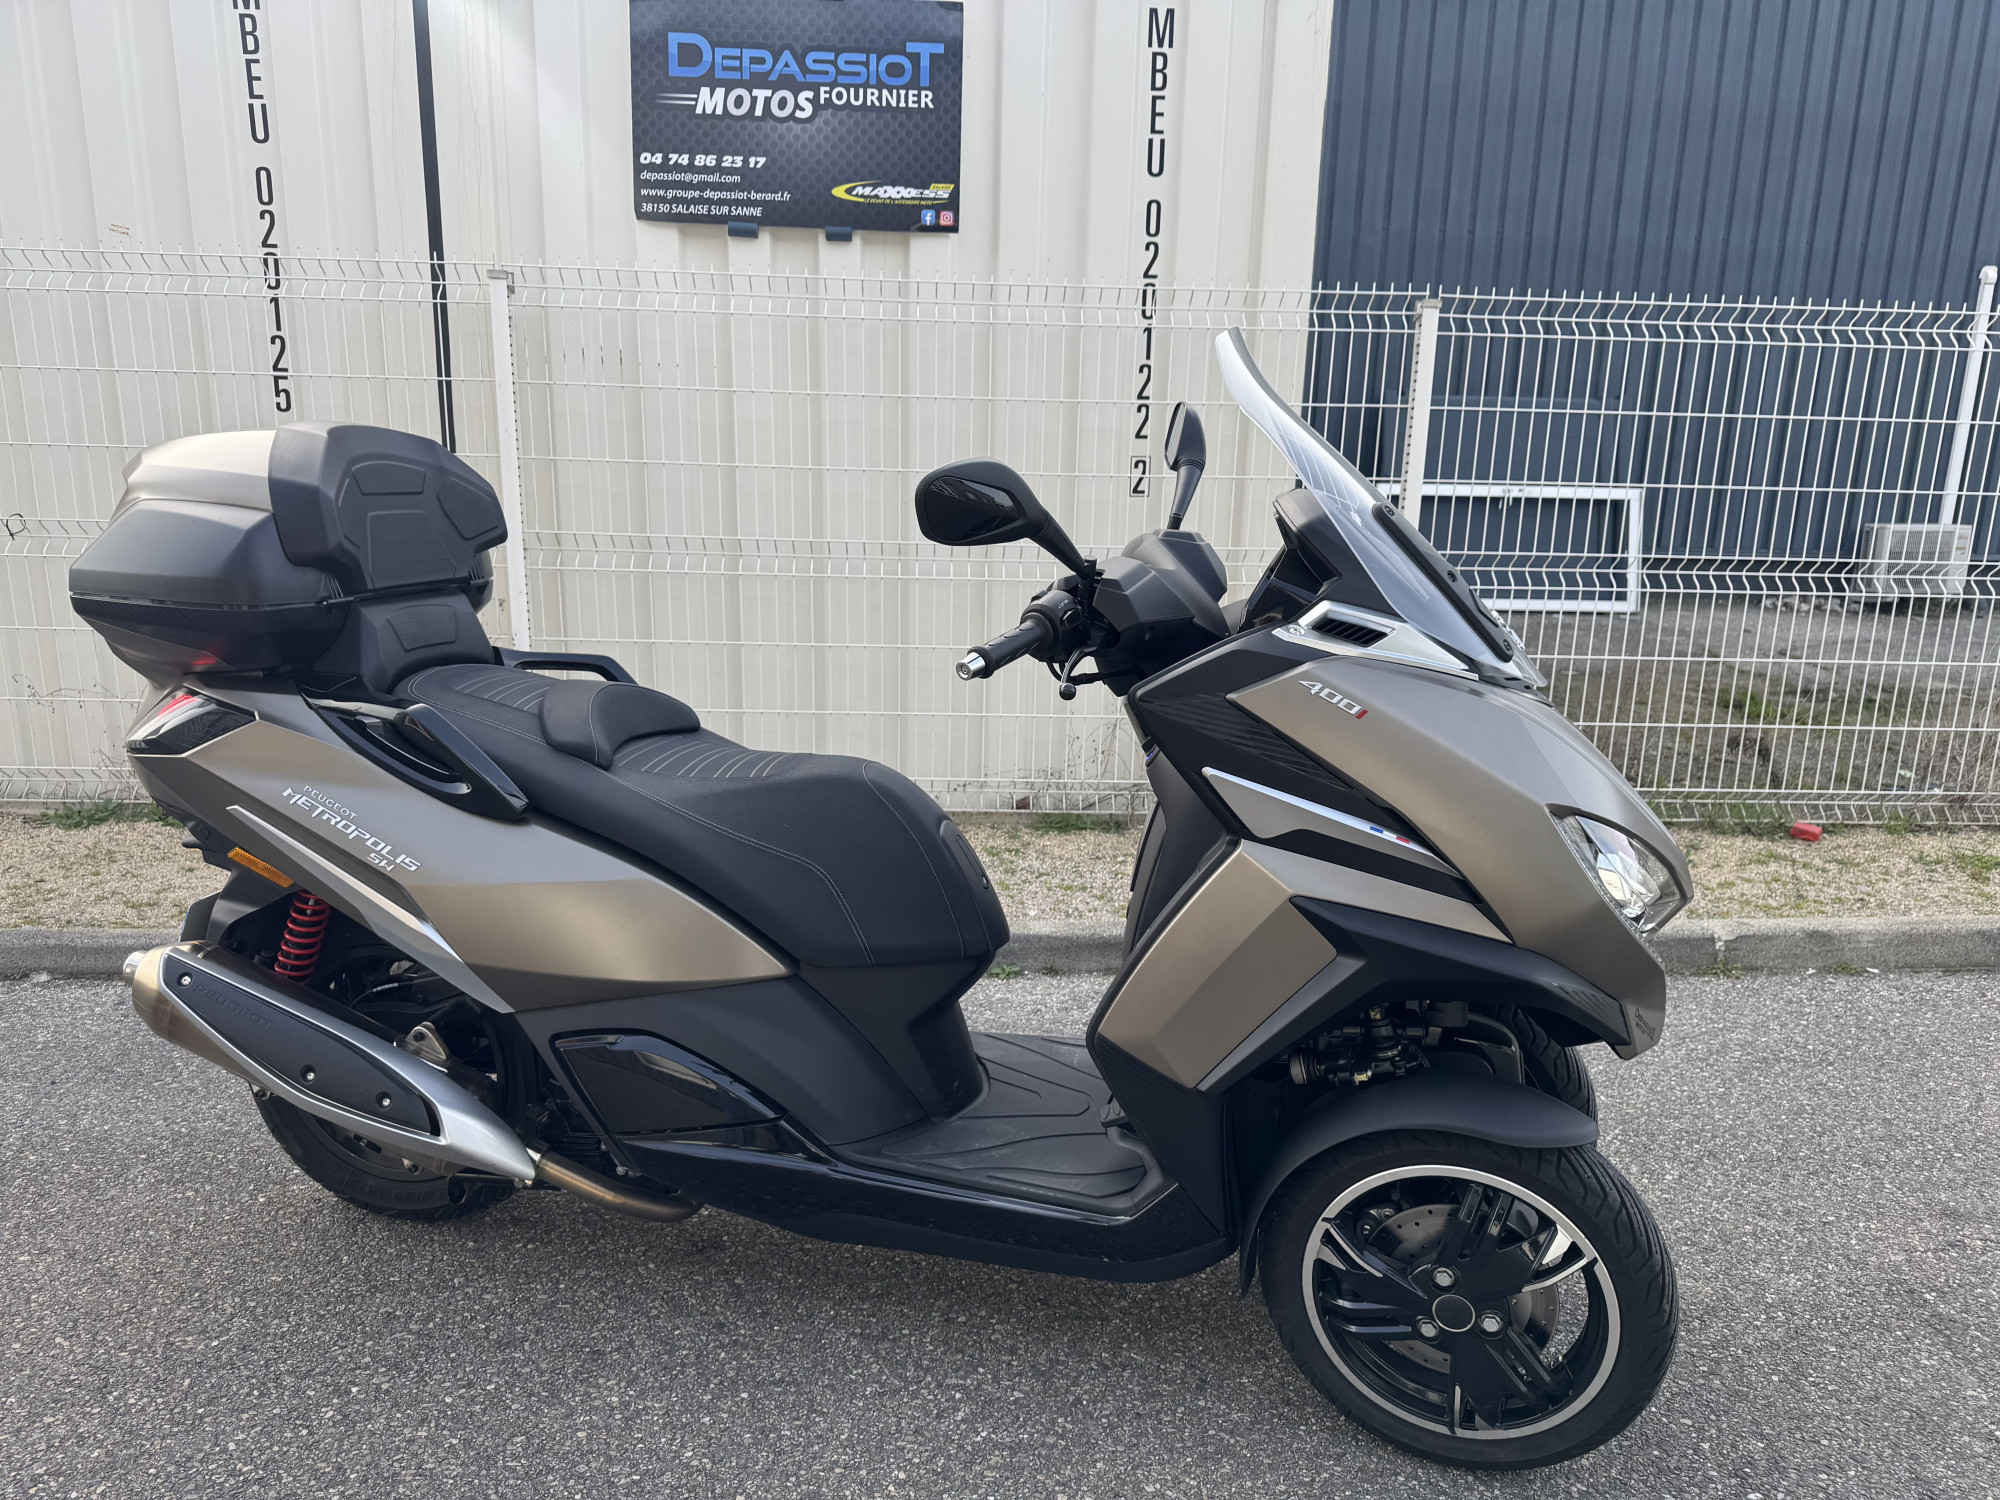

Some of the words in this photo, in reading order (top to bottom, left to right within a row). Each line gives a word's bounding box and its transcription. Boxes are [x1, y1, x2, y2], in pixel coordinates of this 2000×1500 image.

[667, 31, 945, 87] DEPASSIOT
[695, 86, 815, 119] MOTOS
[819, 86, 934, 109] FOURNIER
[1147, 7, 1175, 177] MBEU
[639, 152, 663, 165] 04
[668, 153, 689, 166] 74
[694, 154, 717, 167] 86
[721, 155, 744, 168] 23
[748, 156, 767, 169] 17
[640, 170, 741, 183] depassiot@gmail.com
[232, 0, 270, 144] BEU
[255, 166, 292, 412] 020125
[640, 188, 791, 201] www.groupe-depassiot-berard.fr
[640, 203, 670, 213] 38150
[671, 204, 708, 215] SALAISE
[710, 205, 729, 215] SUR
[730, 205, 763, 216] SANNE
[1134, 199, 1162, 439] 020122
[1132, 460, 1147, 494] 2
[303, 785, 358, 819] PEUGEOT
[281, 787, 422, 872] METROPOLIS
[366, 852, 395, 872] SW
[194, 983, 273, 1032] PEUGEOT
